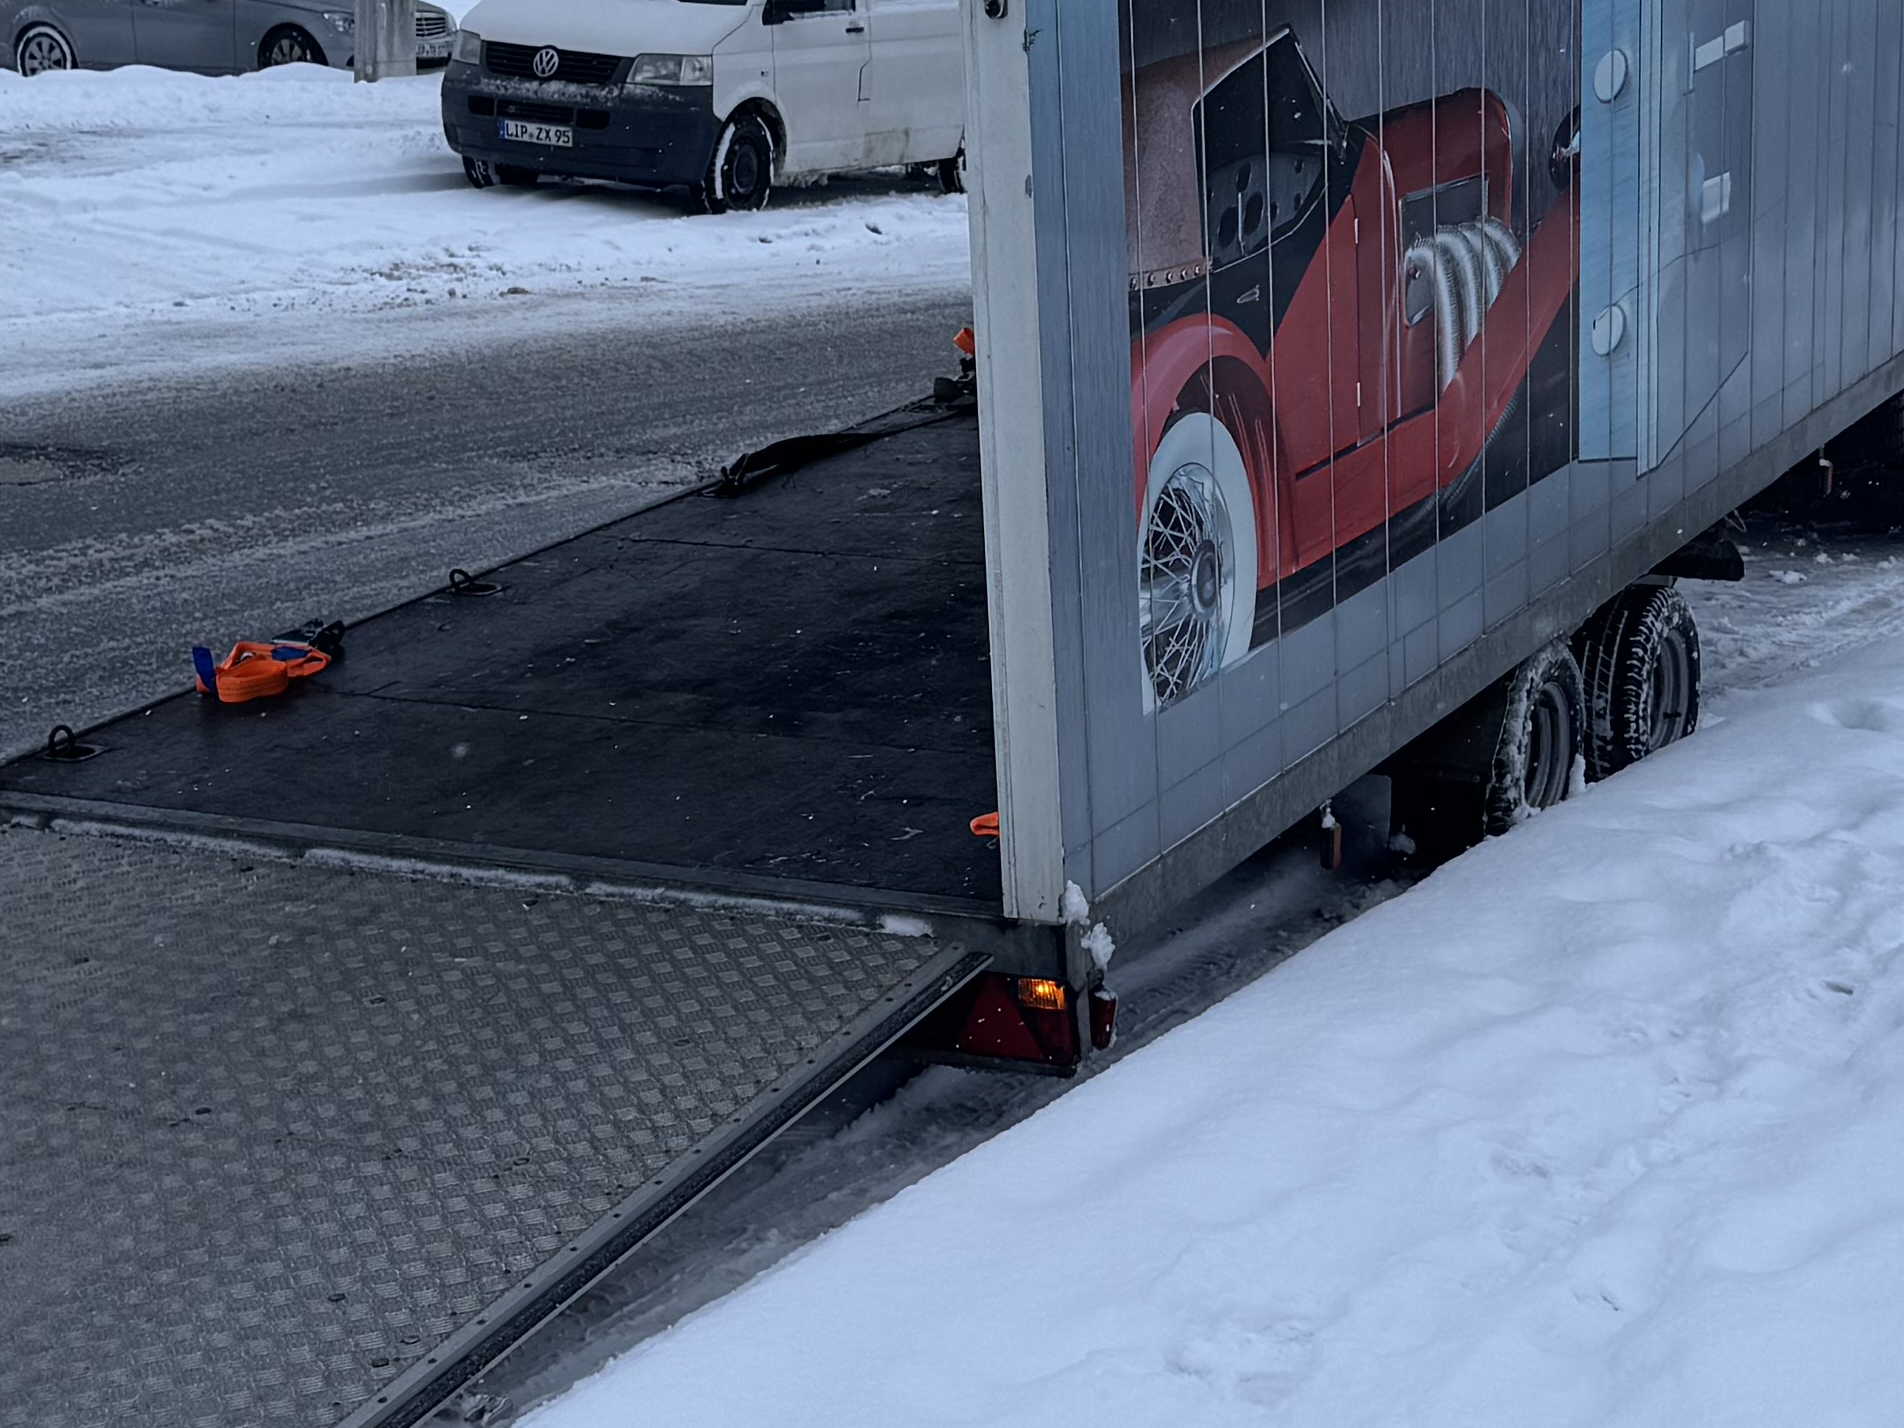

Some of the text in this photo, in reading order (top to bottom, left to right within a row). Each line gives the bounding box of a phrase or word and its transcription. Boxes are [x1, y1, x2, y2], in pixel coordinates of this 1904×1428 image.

[505, 127, 571, 144] LIP ZX 95
